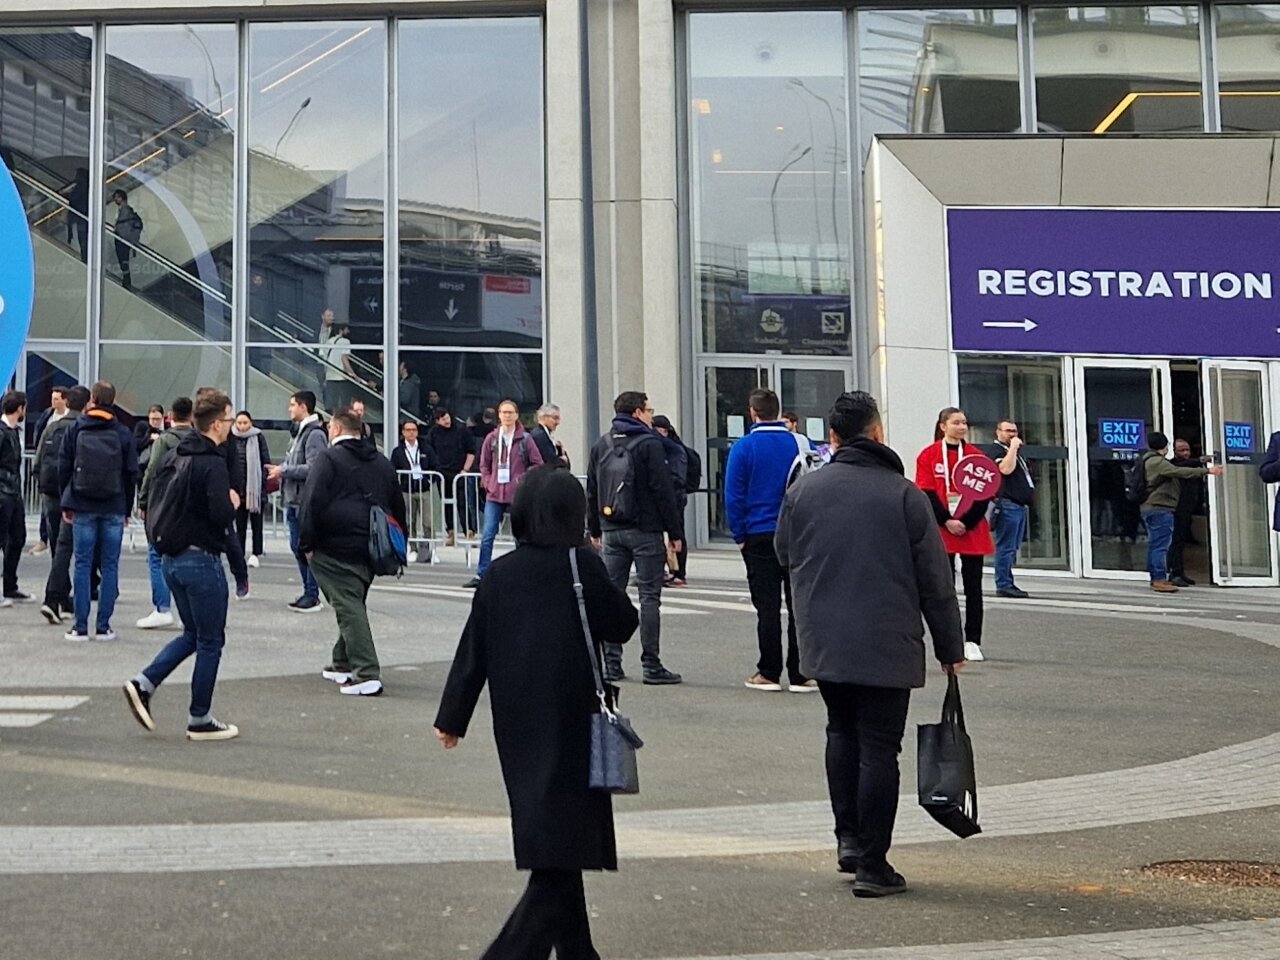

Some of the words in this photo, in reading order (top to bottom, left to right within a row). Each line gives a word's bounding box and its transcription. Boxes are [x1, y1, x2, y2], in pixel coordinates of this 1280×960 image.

[978, 269, 1272, 299] REGISTRATION
[1103, 422, 1140, 434] EXIT
[1225, 426, 1251, 437] EXIT
[1103, 434, 1140, 445] ONLY
[1225, 437, 1251, 449] ONLY
[963, 463, 995, 483] ASK
[962, 475, 986, 493] ME
